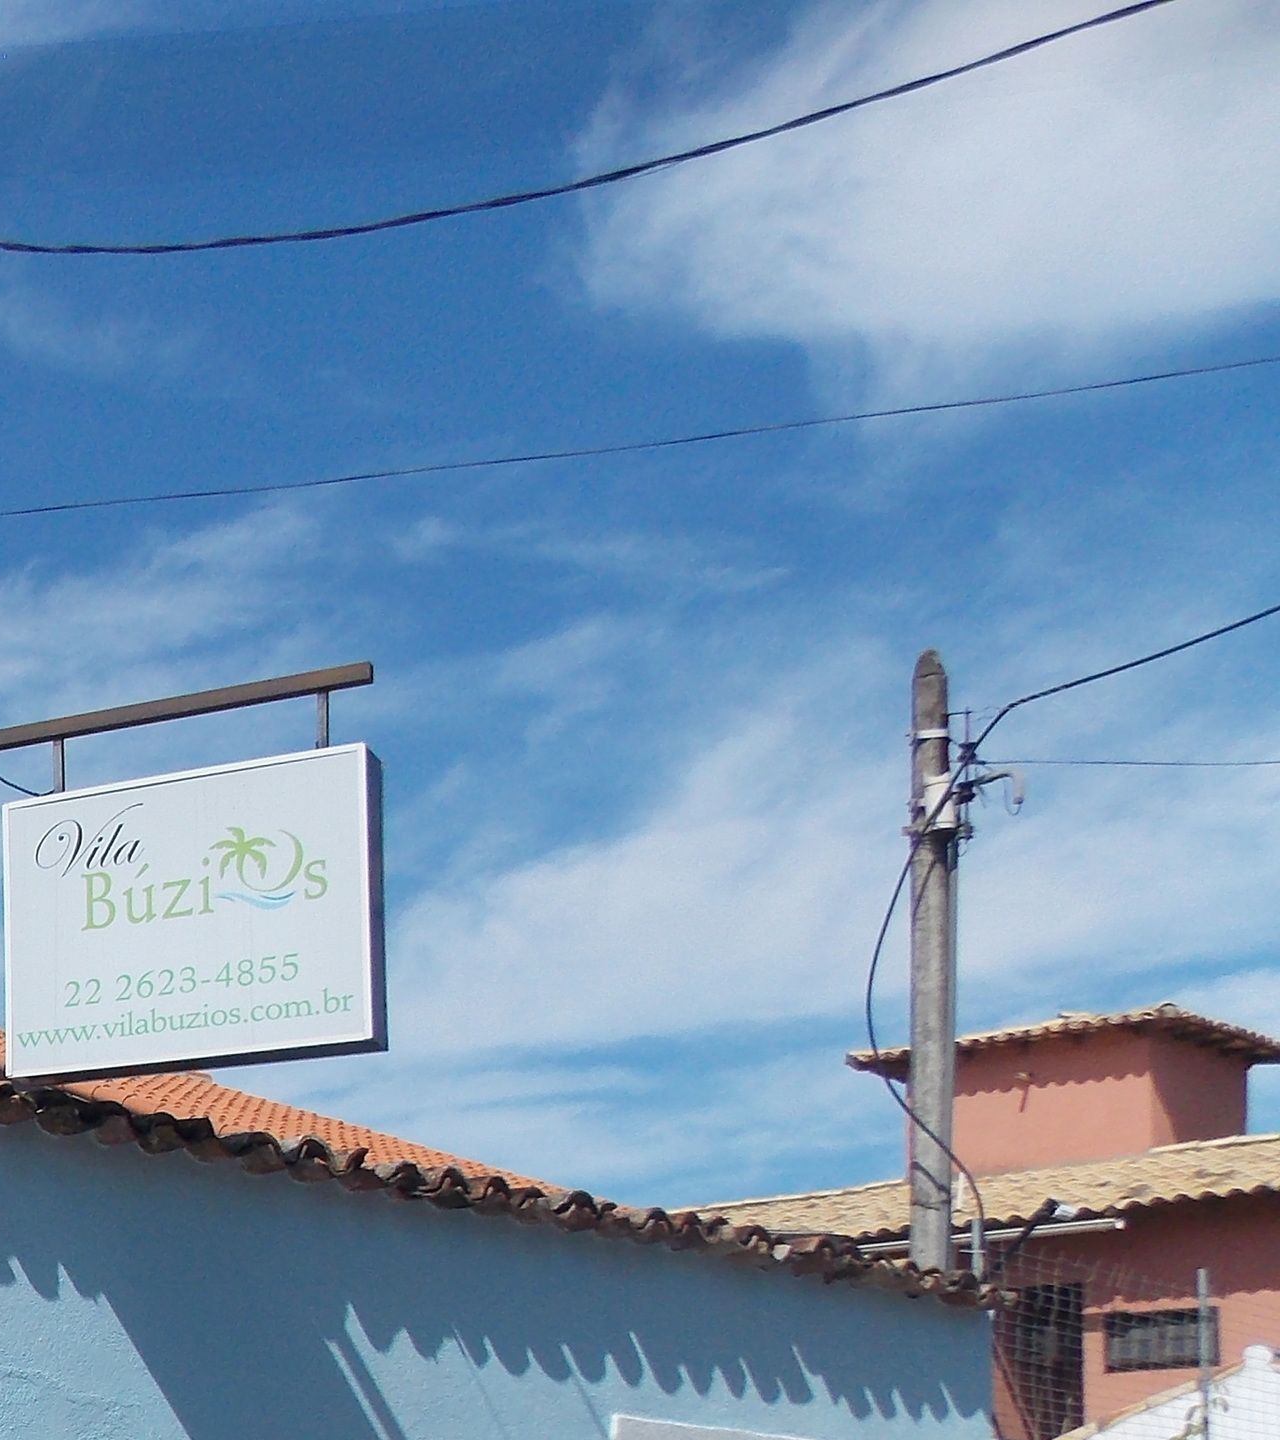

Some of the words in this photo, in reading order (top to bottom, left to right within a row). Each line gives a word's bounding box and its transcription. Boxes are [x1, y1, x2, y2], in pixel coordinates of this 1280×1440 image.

[35, 802, 144, 877] Vila
[64, 978, 102, 1007] 22
[116, 953, 300, 1002] 2623-4855
[17, 988, 354, 1048] www.vilabuzios.com.br
